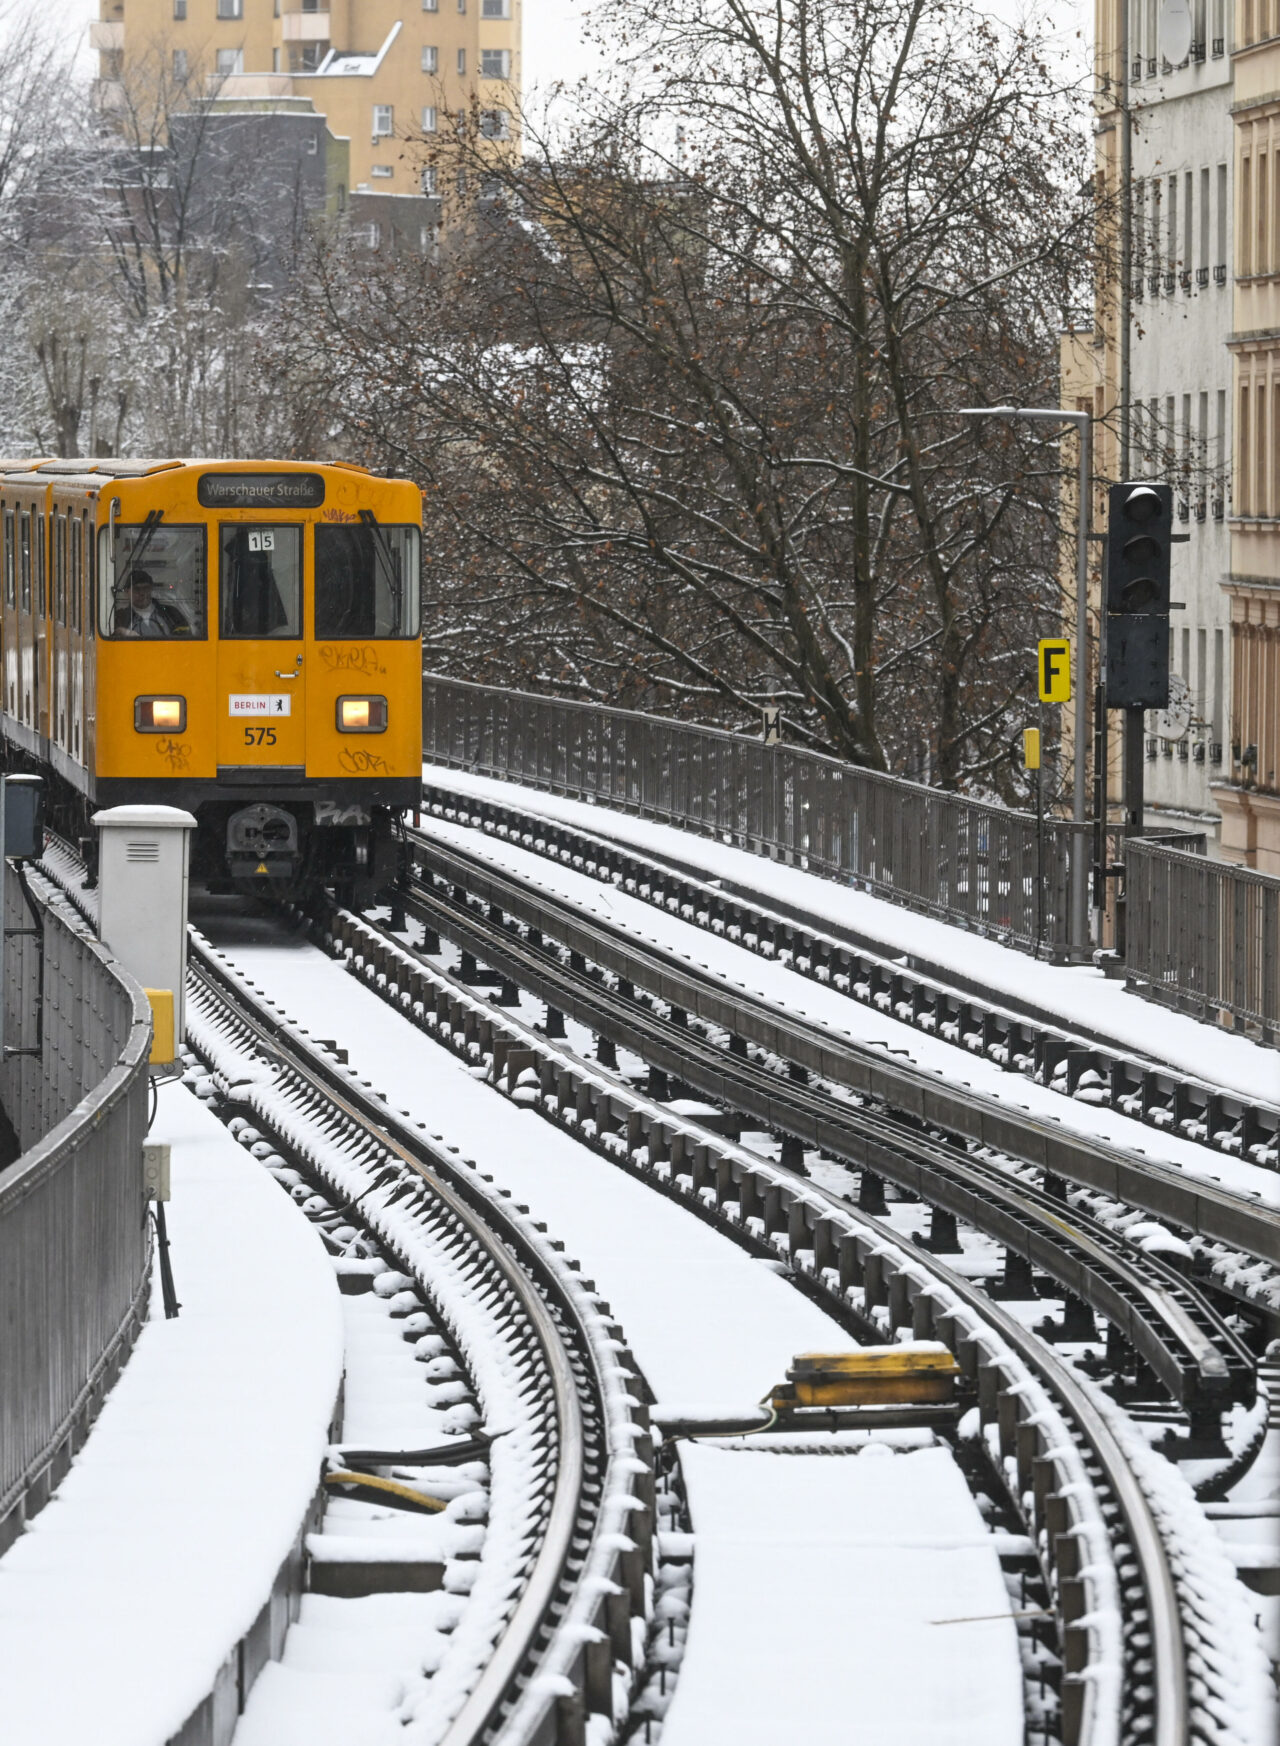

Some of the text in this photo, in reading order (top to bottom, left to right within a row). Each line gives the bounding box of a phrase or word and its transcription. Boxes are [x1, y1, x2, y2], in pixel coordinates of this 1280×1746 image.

[206, 482, 315, 497] Warschauer Straße
[251, 535, 272, 549] 15
[1043, 647, 1066, 695] F
[234, 701, 266, 710] BERLIN
[244, 727, 277, 746] 575
